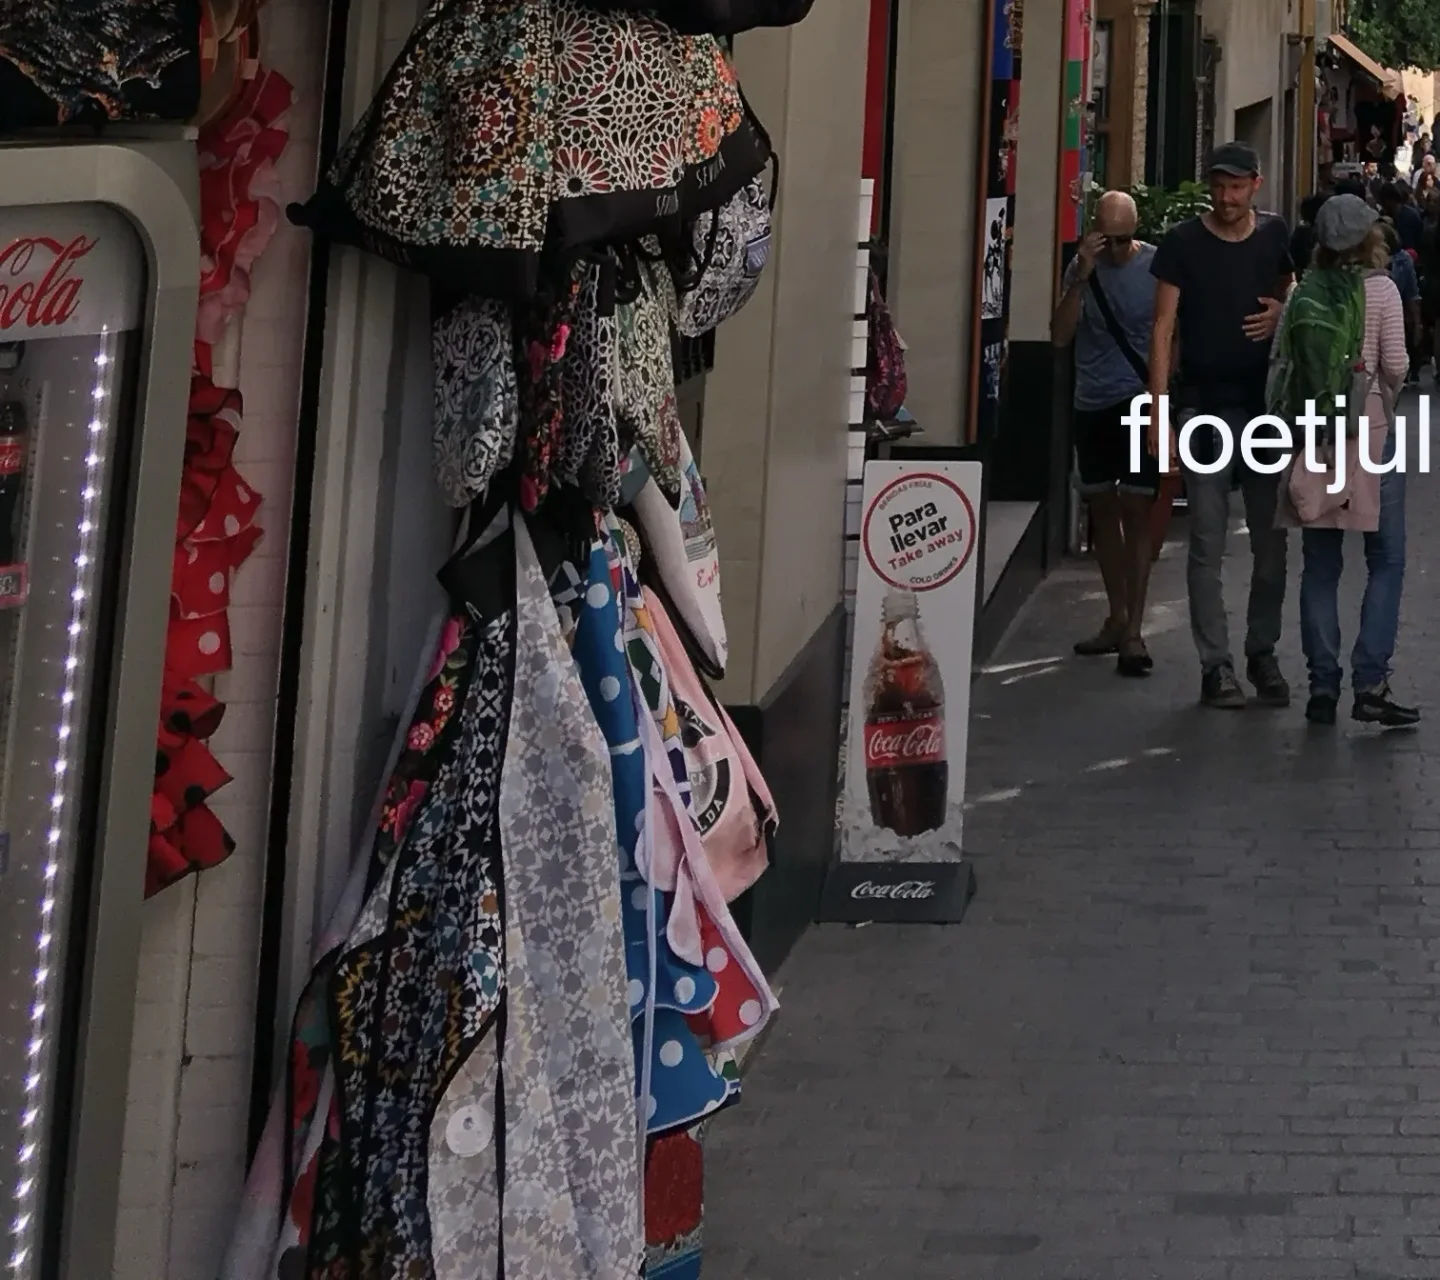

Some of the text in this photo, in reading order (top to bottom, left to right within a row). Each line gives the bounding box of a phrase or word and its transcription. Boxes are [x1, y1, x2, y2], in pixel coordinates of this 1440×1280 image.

[888, 502, 938, 534] Para
[889, 516, 948, 554] llevar
[888, 528, 963, 571] Take away
[909, 574, 933, 584] COLD
